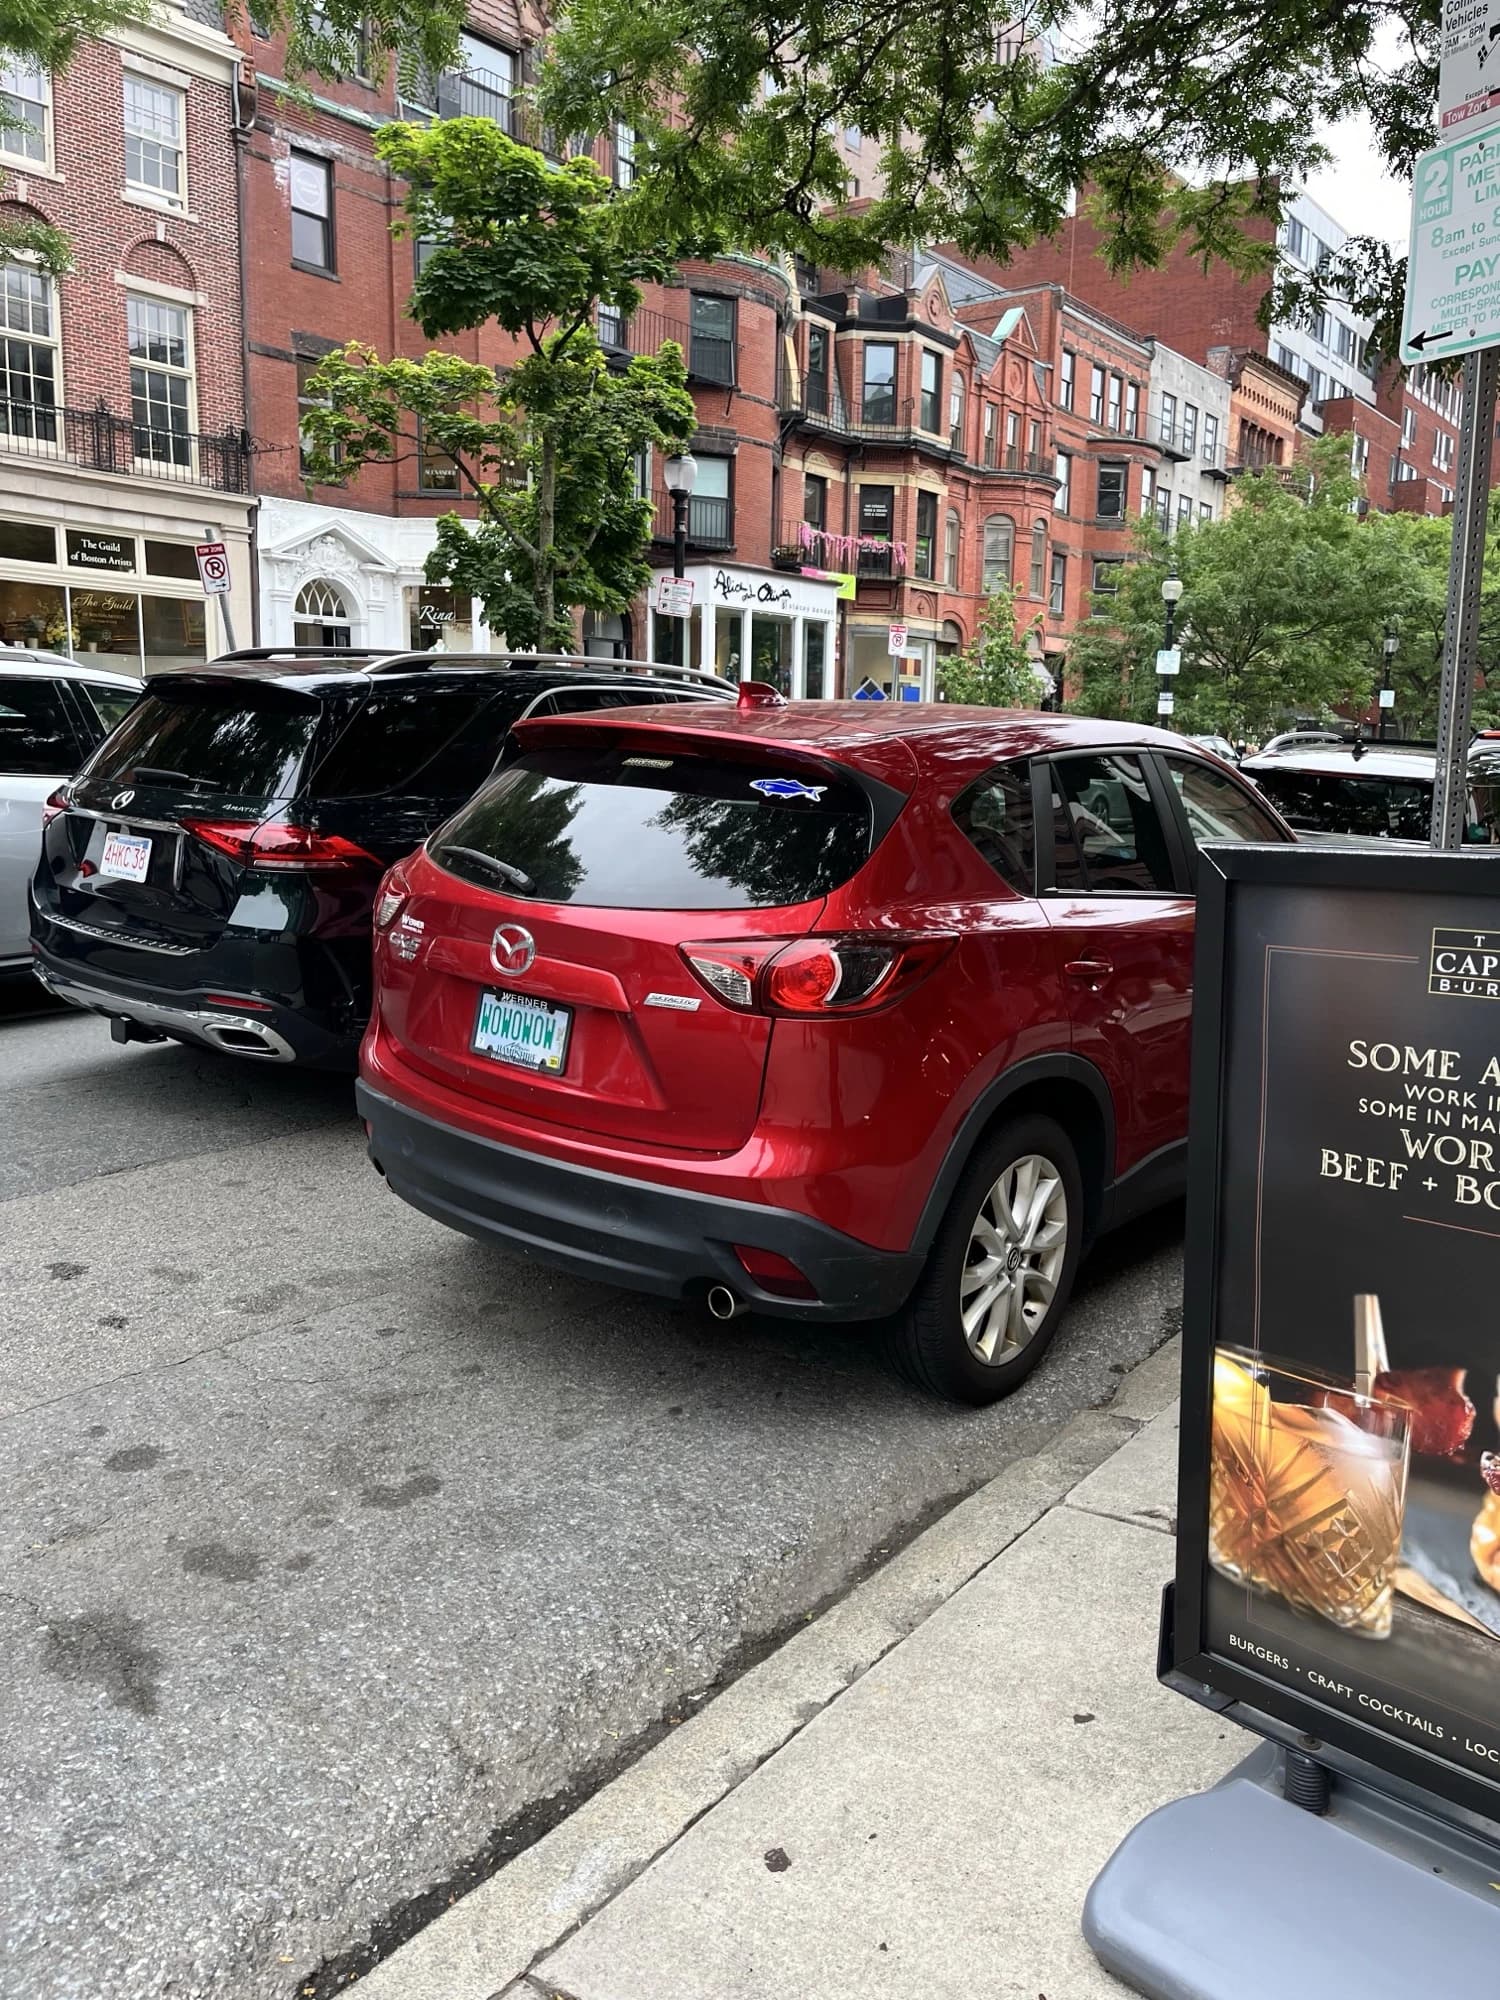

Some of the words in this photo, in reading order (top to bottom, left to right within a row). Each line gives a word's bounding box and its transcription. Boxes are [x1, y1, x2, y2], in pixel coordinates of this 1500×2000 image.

[1446, 3, 1488, 32] Vehicles
[1446, 109, 1466, 125] Tow
[1423, 159, 1449, 204] 2
[1421, 201, 1450, 220] HOUR
[1431, 226, 1465, 249] 8am
[1472, 221, 1486, 235] to
[1441, 242, 1475, 260] Except
[1455, 253, 1500, 286] PAY
[1431, 316, 1468, 335] METER
[1473, 311, 1487, 325] TO
[81, 538, 98, 549] The
[98, 541, 121, 553] Guild
[70, 551, 79, 561] of
[81, 552, 107, 564] Boston
[108, 556, 133, 567] Artists
[75, 593, 98, 606] The
[101, 594, 134, 610] Guild
[419, 604, 454, 624] Rina
[1474, 935, 1486, 948] T
[1436, 952, 1499, 976] CAP
[502, 992, 548, 1010] WERNER
[480, 1002, 556, 1050] WOWOWOW
[1348, 1040, 1461, 1082] SOME
[1404, 1083, 1478, 1109] WORK
[1488, 1095, 1500, 1112] I
[1358, 1098, 1418, 1122] SOME
[1427, 1108, 1451, 1127] IN
[1461, 1113, 1500, 1136] MA
[1320, 1148, 1409, 1190] BEEF
[1422, 1176, 1439, 1191] +
[1229, 1633, 1290, 1670] BURGERS
[1307, 1670, 1354, 1699] CRAFT
[1358, 1693, 1444, 1738] COCKTAILS
